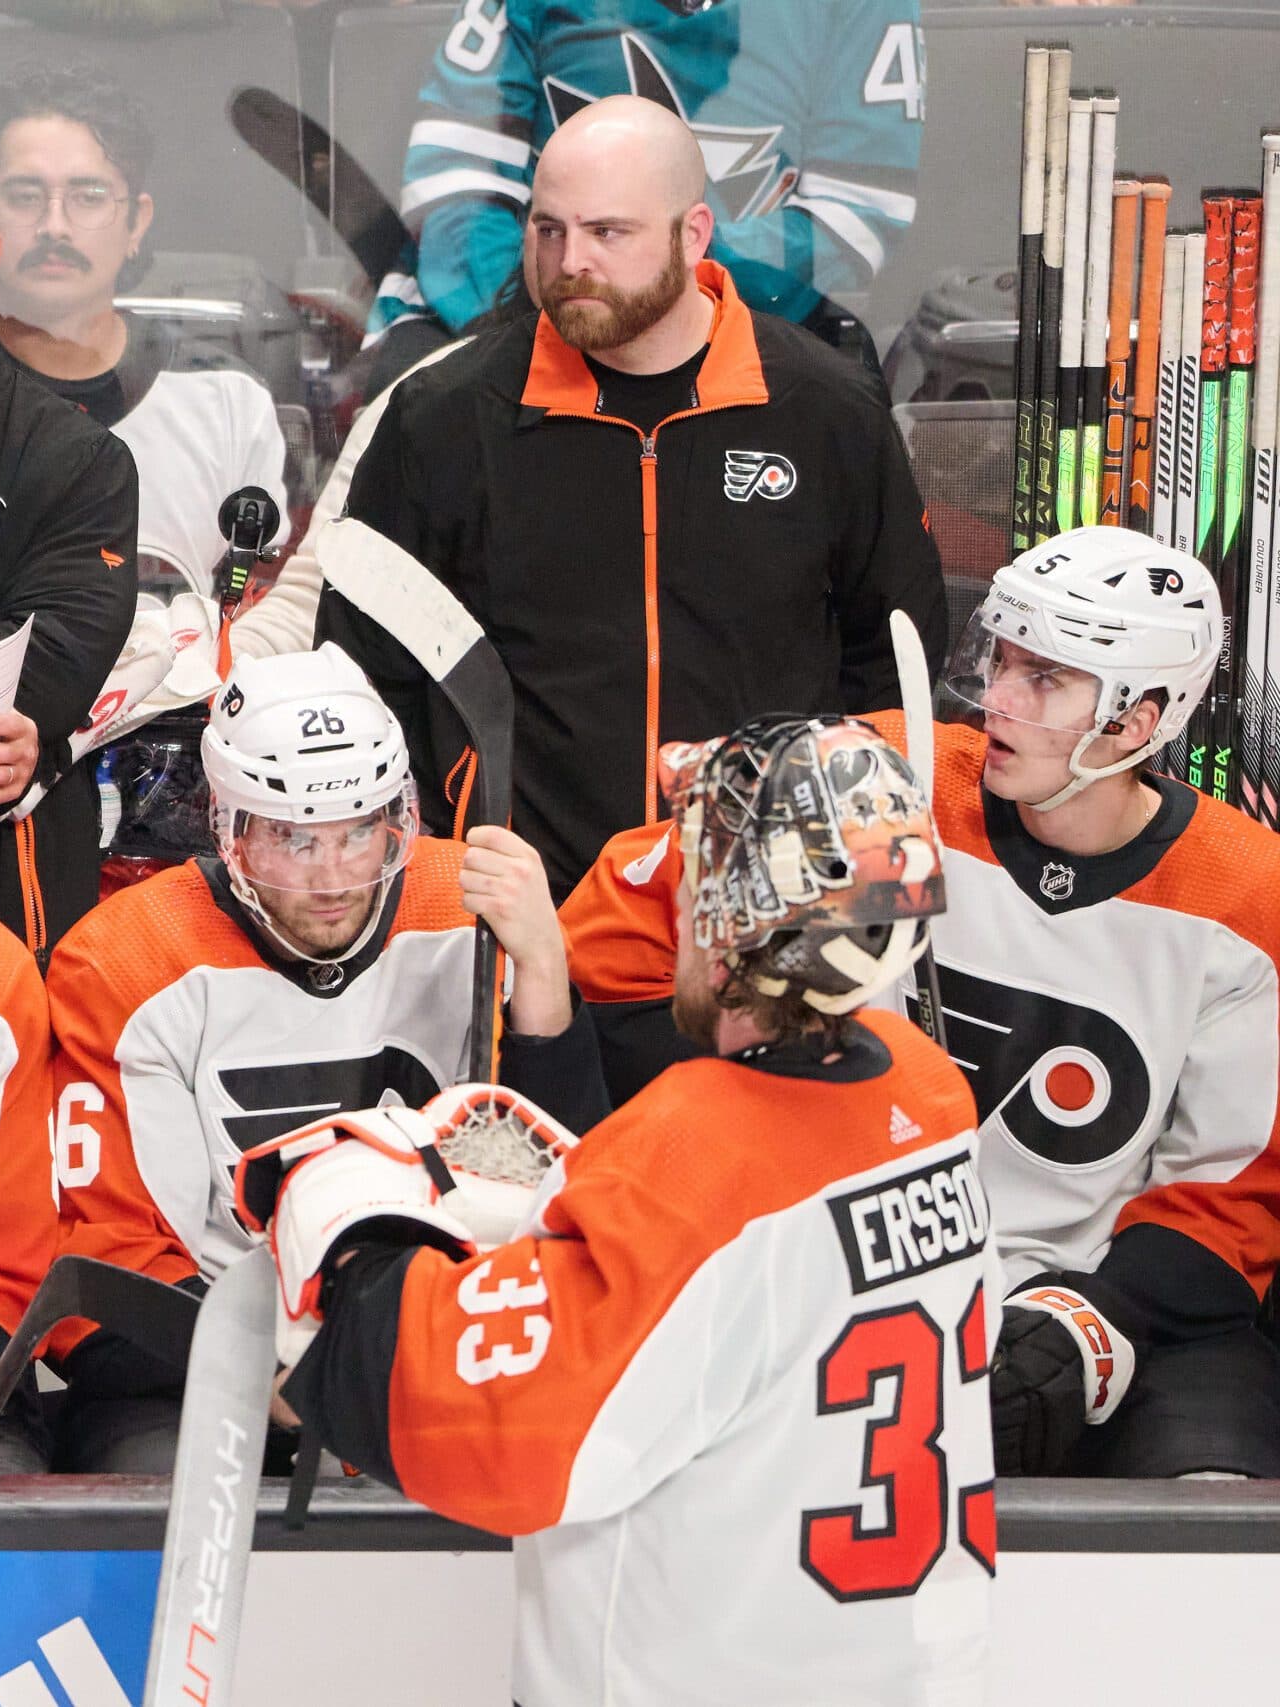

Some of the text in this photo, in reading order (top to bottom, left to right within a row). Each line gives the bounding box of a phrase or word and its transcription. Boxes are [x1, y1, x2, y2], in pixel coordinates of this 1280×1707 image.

[863, 22, 927, 122] 4
[1157, 359, 1175, 500] ARRIOR
[1035, 553, 1072, 575] 5
[1255, 538, 1265, 594] COUTURIER
[1220, 615, 1232, 673] KONECNY
[297, 706, 345, 738] 26
[305, 777, 361, 793] CCM
[56, 1081, 105, 1189] 6
[849, 1160, 990, 1282] ERSSO
[456, 1258, 553, 1386] 33
[1025, 1289, 1114, 1409] CCM
[181, 1417, 249, 1707] HYPERLIT
